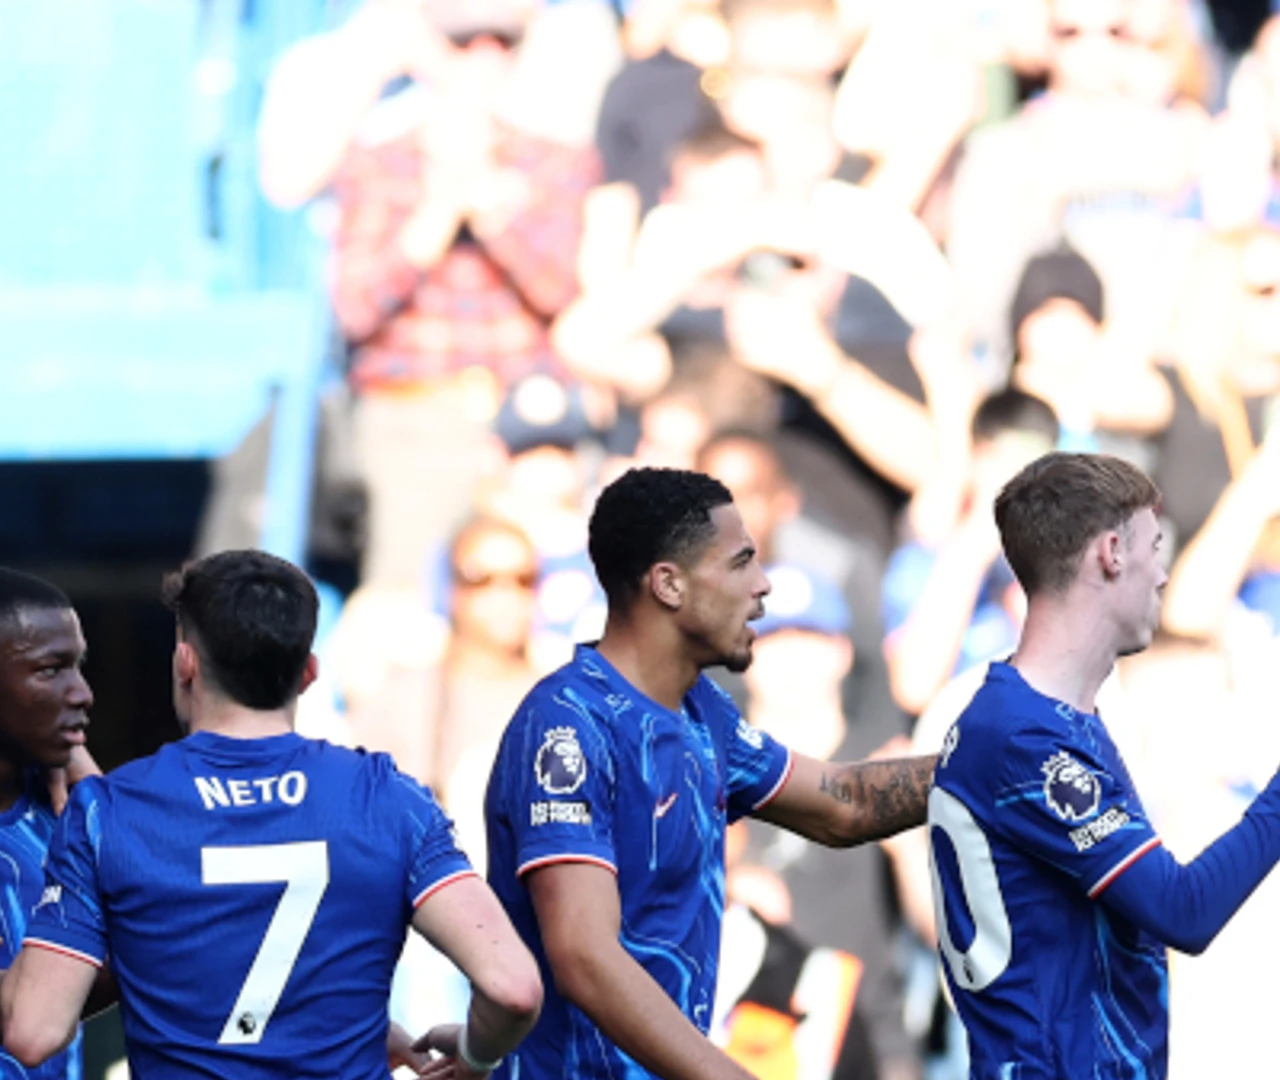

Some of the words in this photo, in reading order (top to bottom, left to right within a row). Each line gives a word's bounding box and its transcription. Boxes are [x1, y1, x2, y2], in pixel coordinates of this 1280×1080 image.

[194, 770, 308, 811] NETO
[927, 785, 1012, 992] 0
[201, 840, 330, 1044] 7
